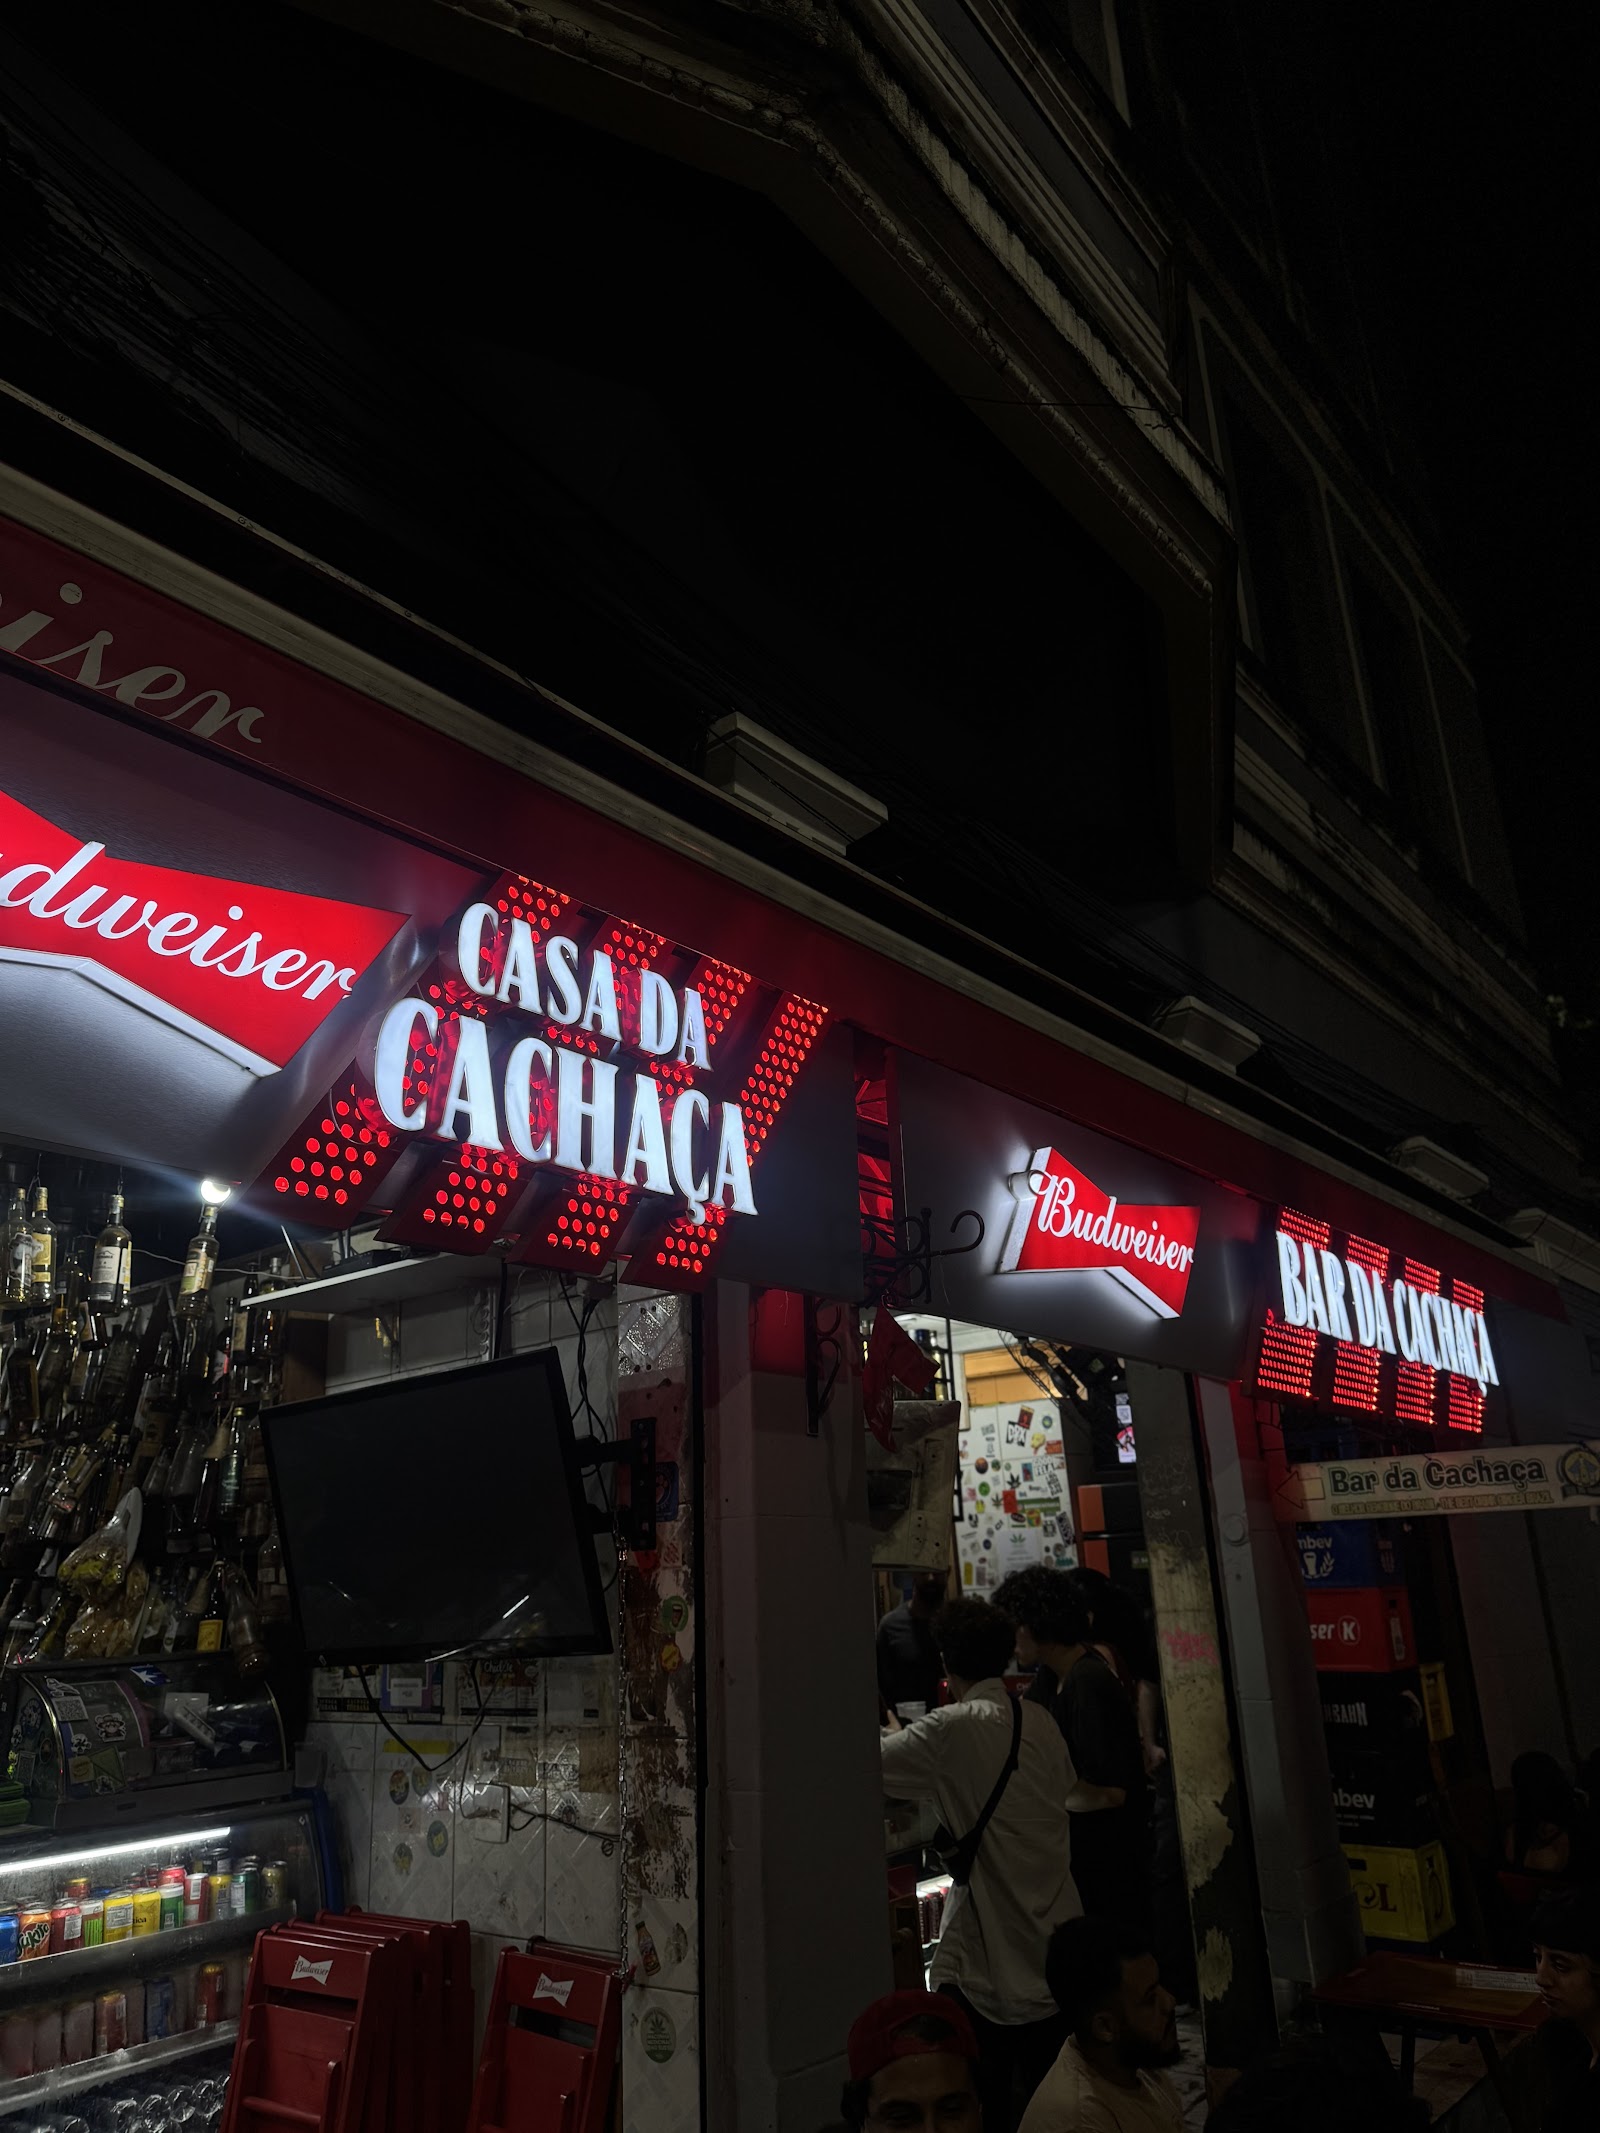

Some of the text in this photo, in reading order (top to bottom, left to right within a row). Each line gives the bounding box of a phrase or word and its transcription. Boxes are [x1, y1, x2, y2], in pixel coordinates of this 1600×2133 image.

[0, 582, 264, 744] iser
[0, 840, 356, 1001] dweiser
[457, 902, 713, 1071] CASA DA
[374, 998, 759, 1226] CACHAÇA
[1028, 1168, 1194, 1273] Budweiser
[1276, 1231, 1500, 1398] BAR DA CACHAÇA
[1330, 1456, 1547, 1495] Bar da Cachaça
[1342, 1621, 1357, 1641] K
